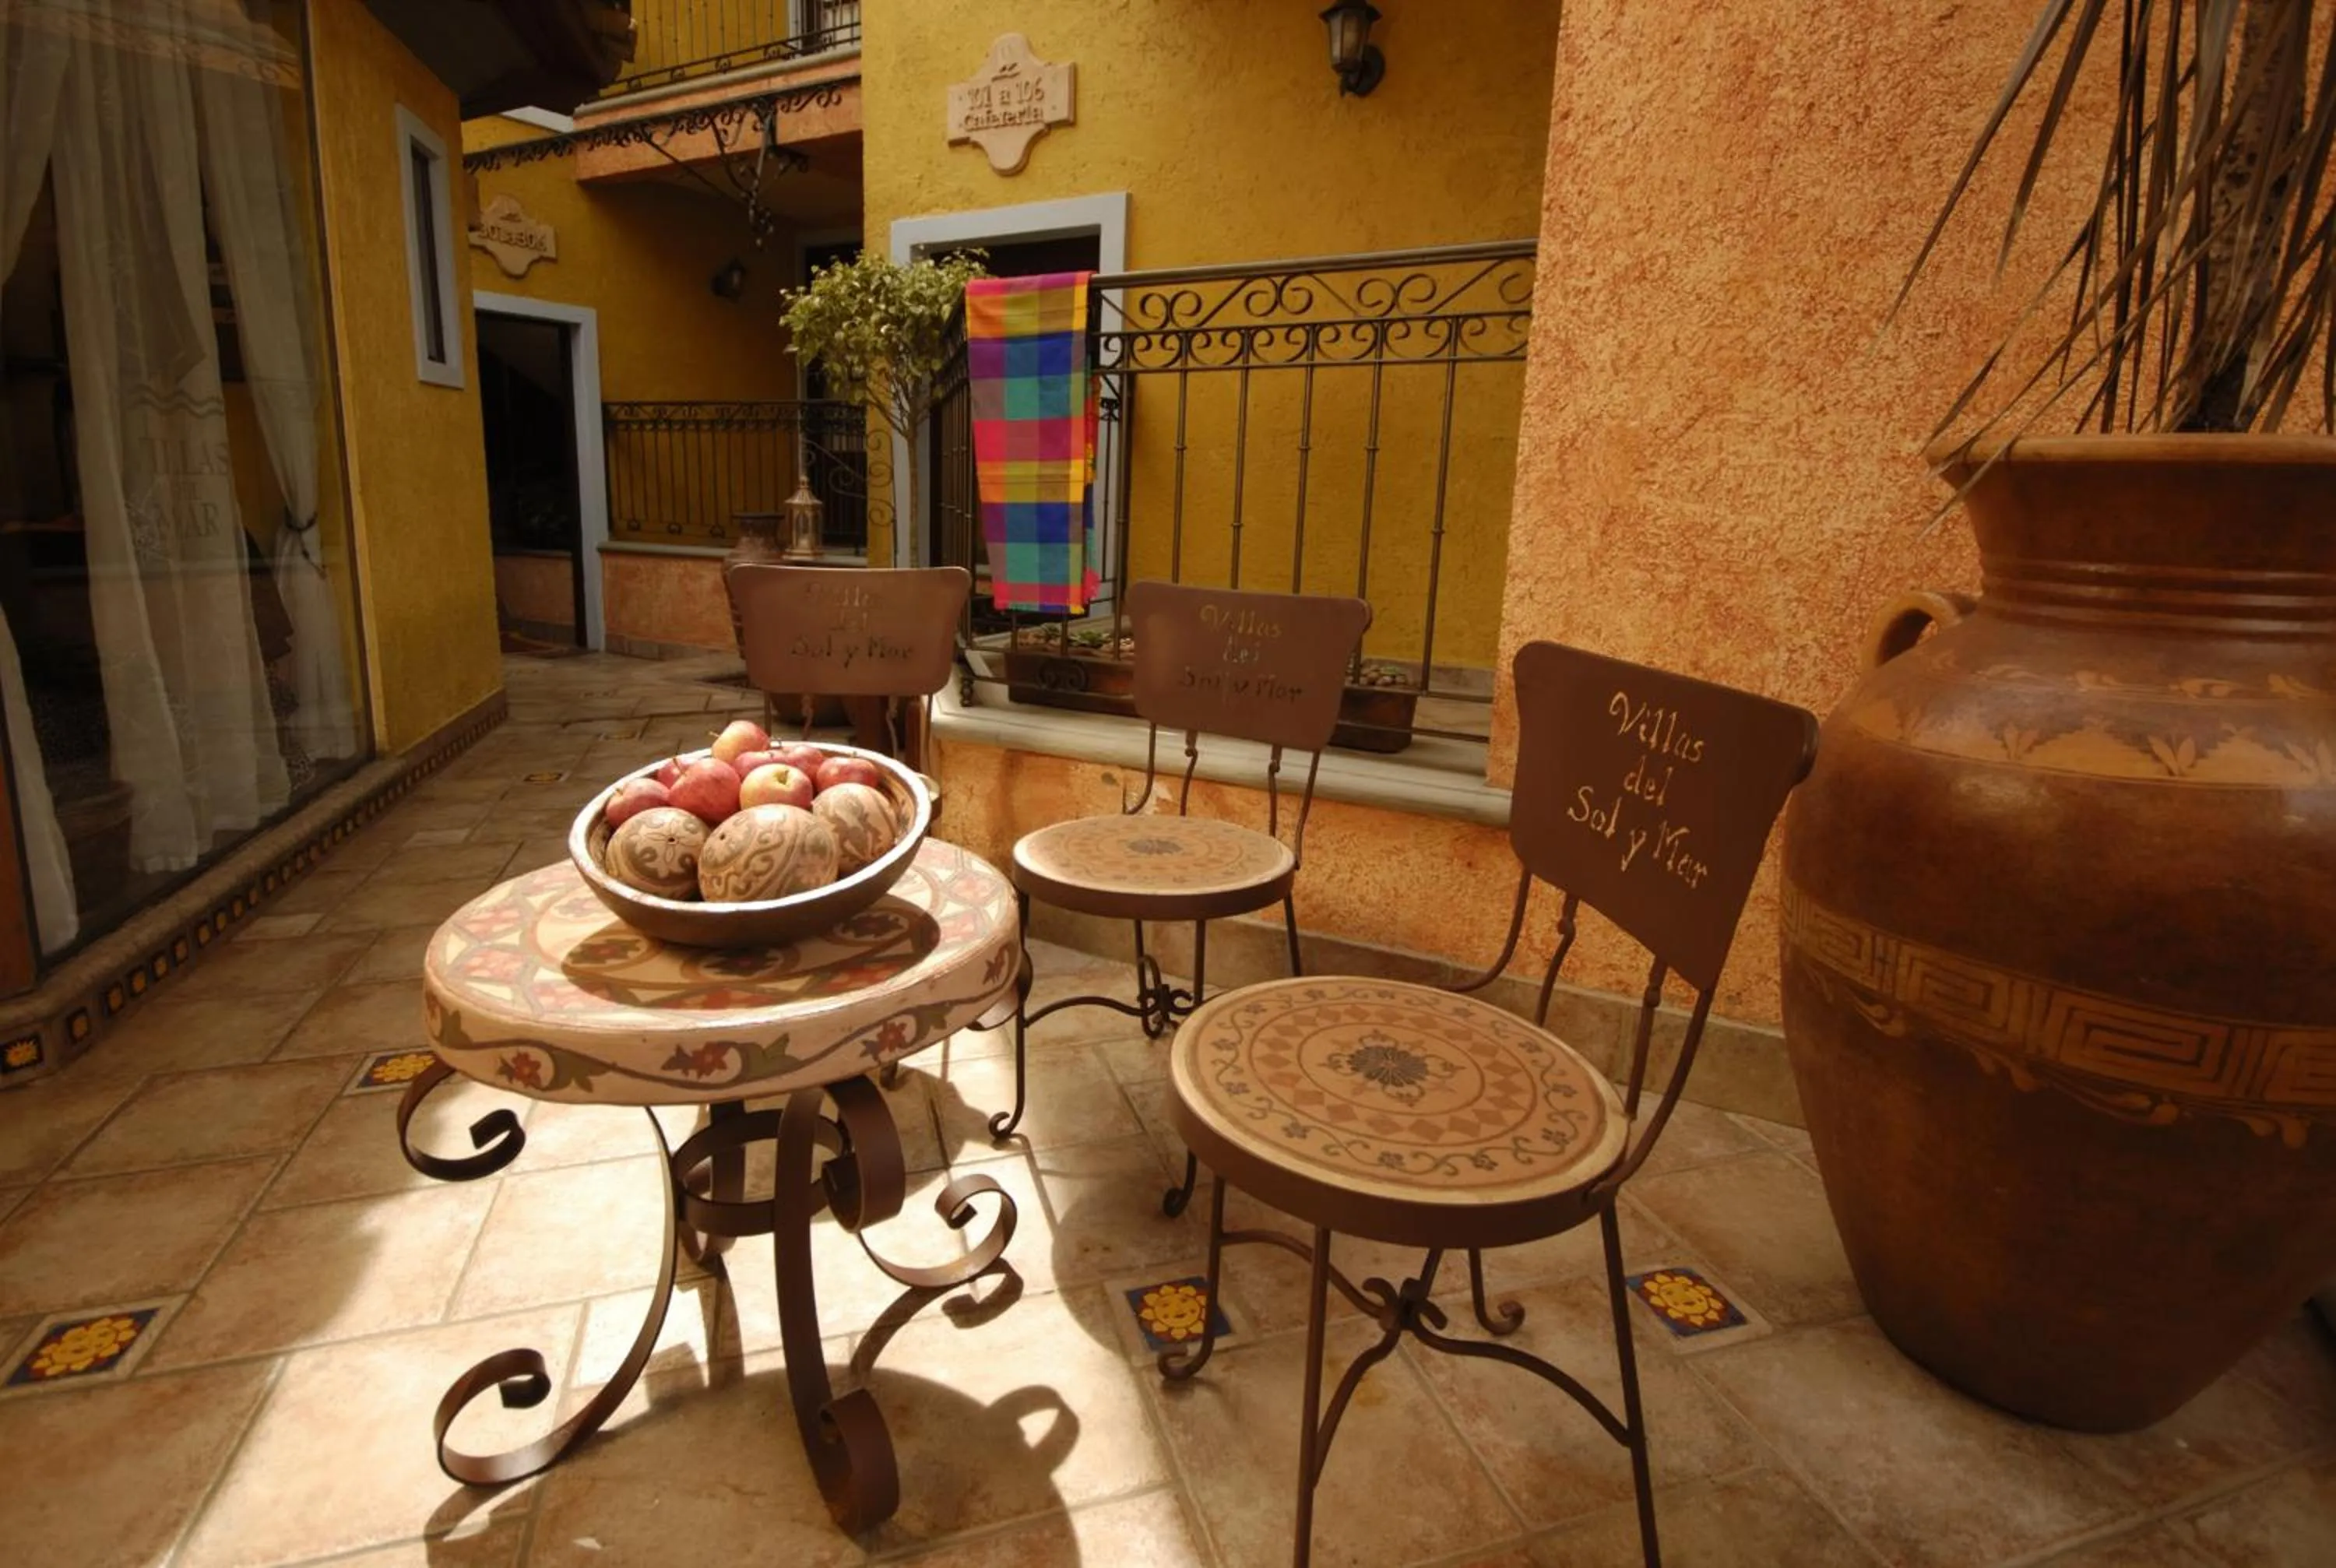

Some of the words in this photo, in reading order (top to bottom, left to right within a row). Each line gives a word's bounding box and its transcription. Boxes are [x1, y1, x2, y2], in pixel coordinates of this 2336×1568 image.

[967, 86, 992, 111] 101
[1015, 76, 1045, 103] 106
[1608, 691, 1705, 763] Villas
[1623, 754, 1675, 807] del
[1566, 785, 1622, 839] Sol
[1620, 828, 1648, 873] y
[1652, 820, 1708, 889] Mar
